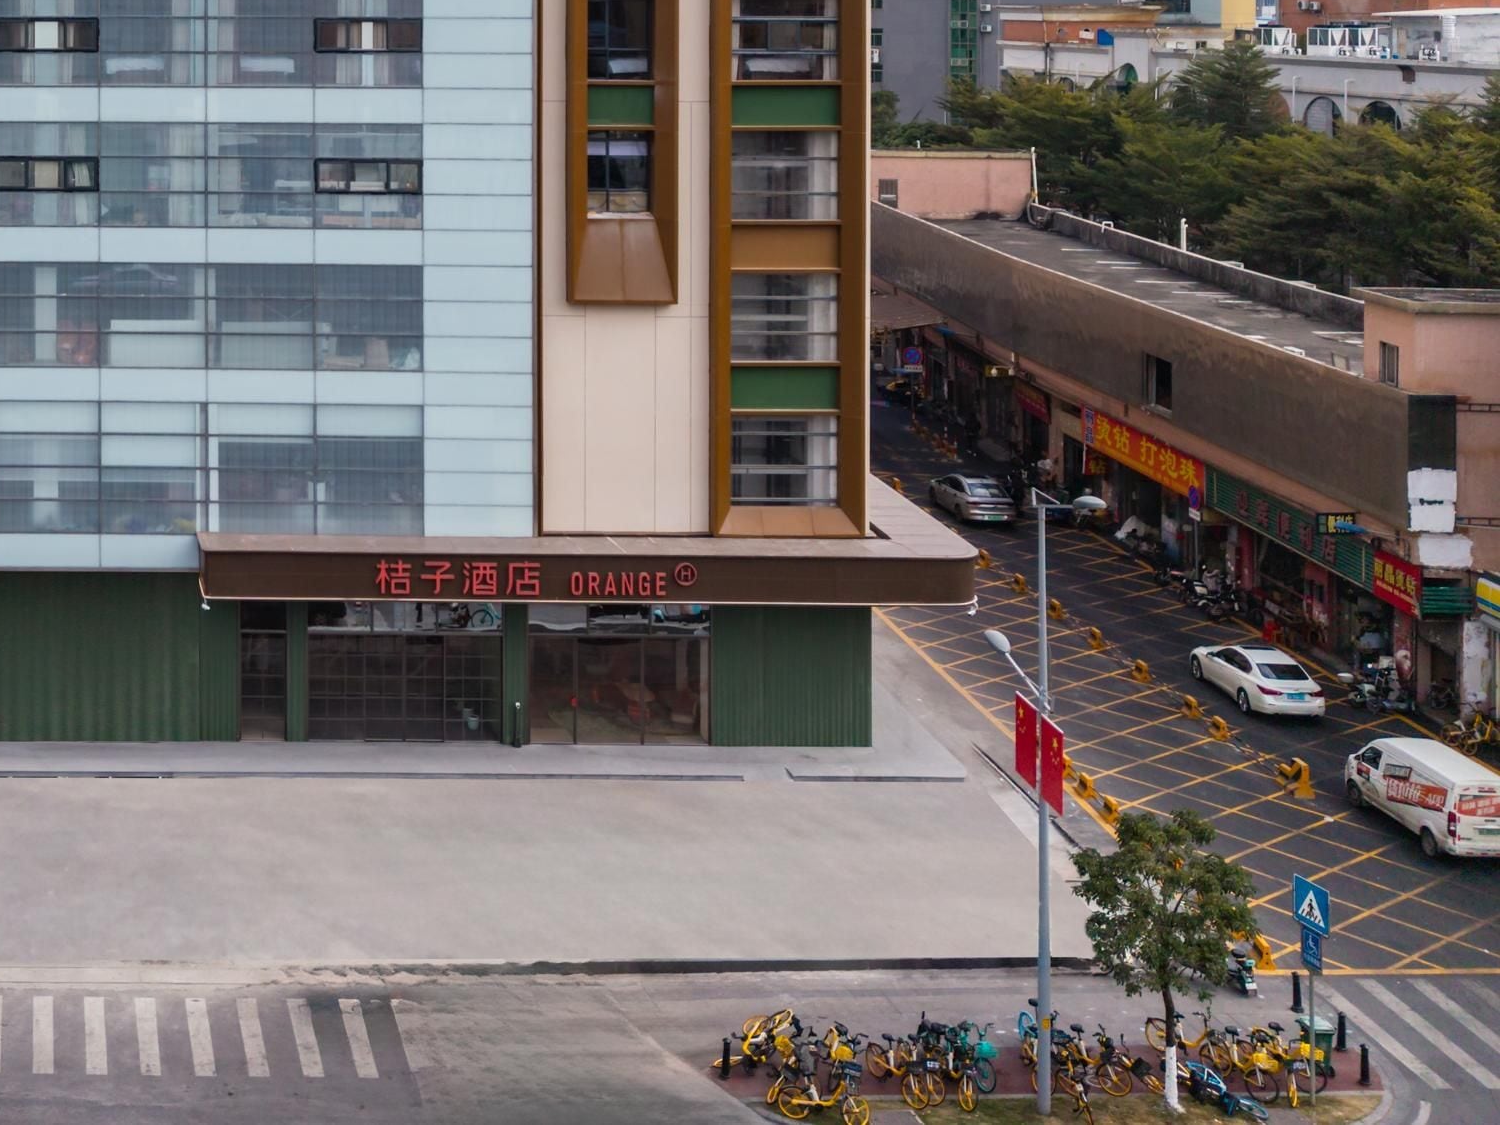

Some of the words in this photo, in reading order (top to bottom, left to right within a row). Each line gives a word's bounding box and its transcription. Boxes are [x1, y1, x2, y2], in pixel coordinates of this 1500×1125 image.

[375, 560, 541, 596] 桔子酒店
[570, 571, 668, 596] ORANGE
